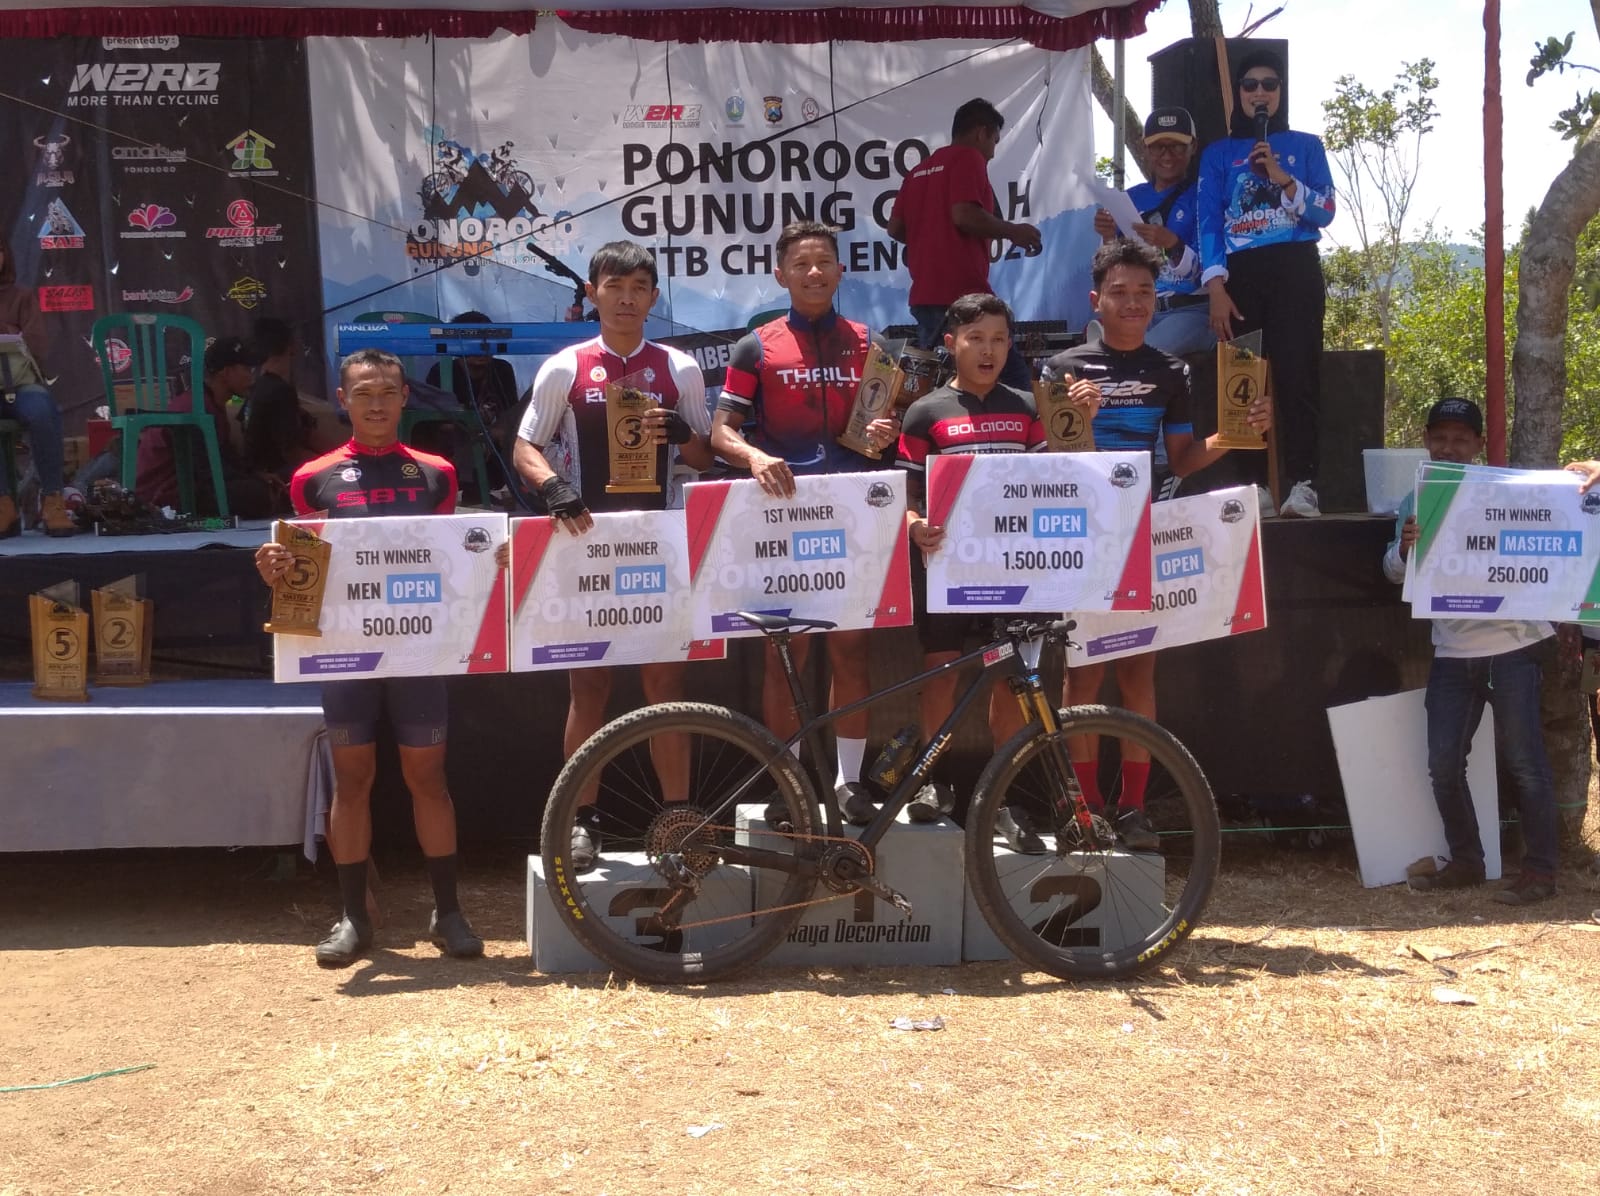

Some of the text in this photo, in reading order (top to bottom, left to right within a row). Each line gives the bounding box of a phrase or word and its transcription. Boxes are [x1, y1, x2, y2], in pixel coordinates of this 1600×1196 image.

[69, 62, 222, 92] W2RB
[67, 94, 219, 107] MORE THAN CYCLING
[623, 139, 931, 185] PONOROGO
[621, 191, 856, 237] GUNUNG
[776, 367, 862, 385] THRILL
[1003, 483, 1079, 499] 2ND WINNER
[764, 505, 834, 524] 1ST WINNER
[994, 515, 1081, 533] MEN OPEN
[1485, 508, 1552, 522] 5TH WINNER
[1151, 526, 1194, 546] WINNER
[1466, 535, 1578, 552] MEN MASTER A
[355, 548, 431, 566] 5TH WINNER
[587, 541, 659, 558] 3RD WINNER
[755, 536, 840, 558] MEN OPEN
[1002, 550, 1084, 571] 1.500.000
[1161, 554, 1200, 577] OPEN
[578, 571, 661, 592] MEN OPEN
[763, 571, 846, 595] 2.000.000
[1487, 566, 1549, 583] 250.000
[347, 580, 436, 600] MEN OPEN
[362, 616, 433, 637] 500.000
[585, 605, 663, 627] 1.000.000
[912, 732, 952, 777] THRILL
[554, 856, 584, 920] MAXXIS
[1029, 875, 1102, 947] 2
[834, 918, 931, 943] Decoration
[1137, 919, 1188, 963] MAXXIS
